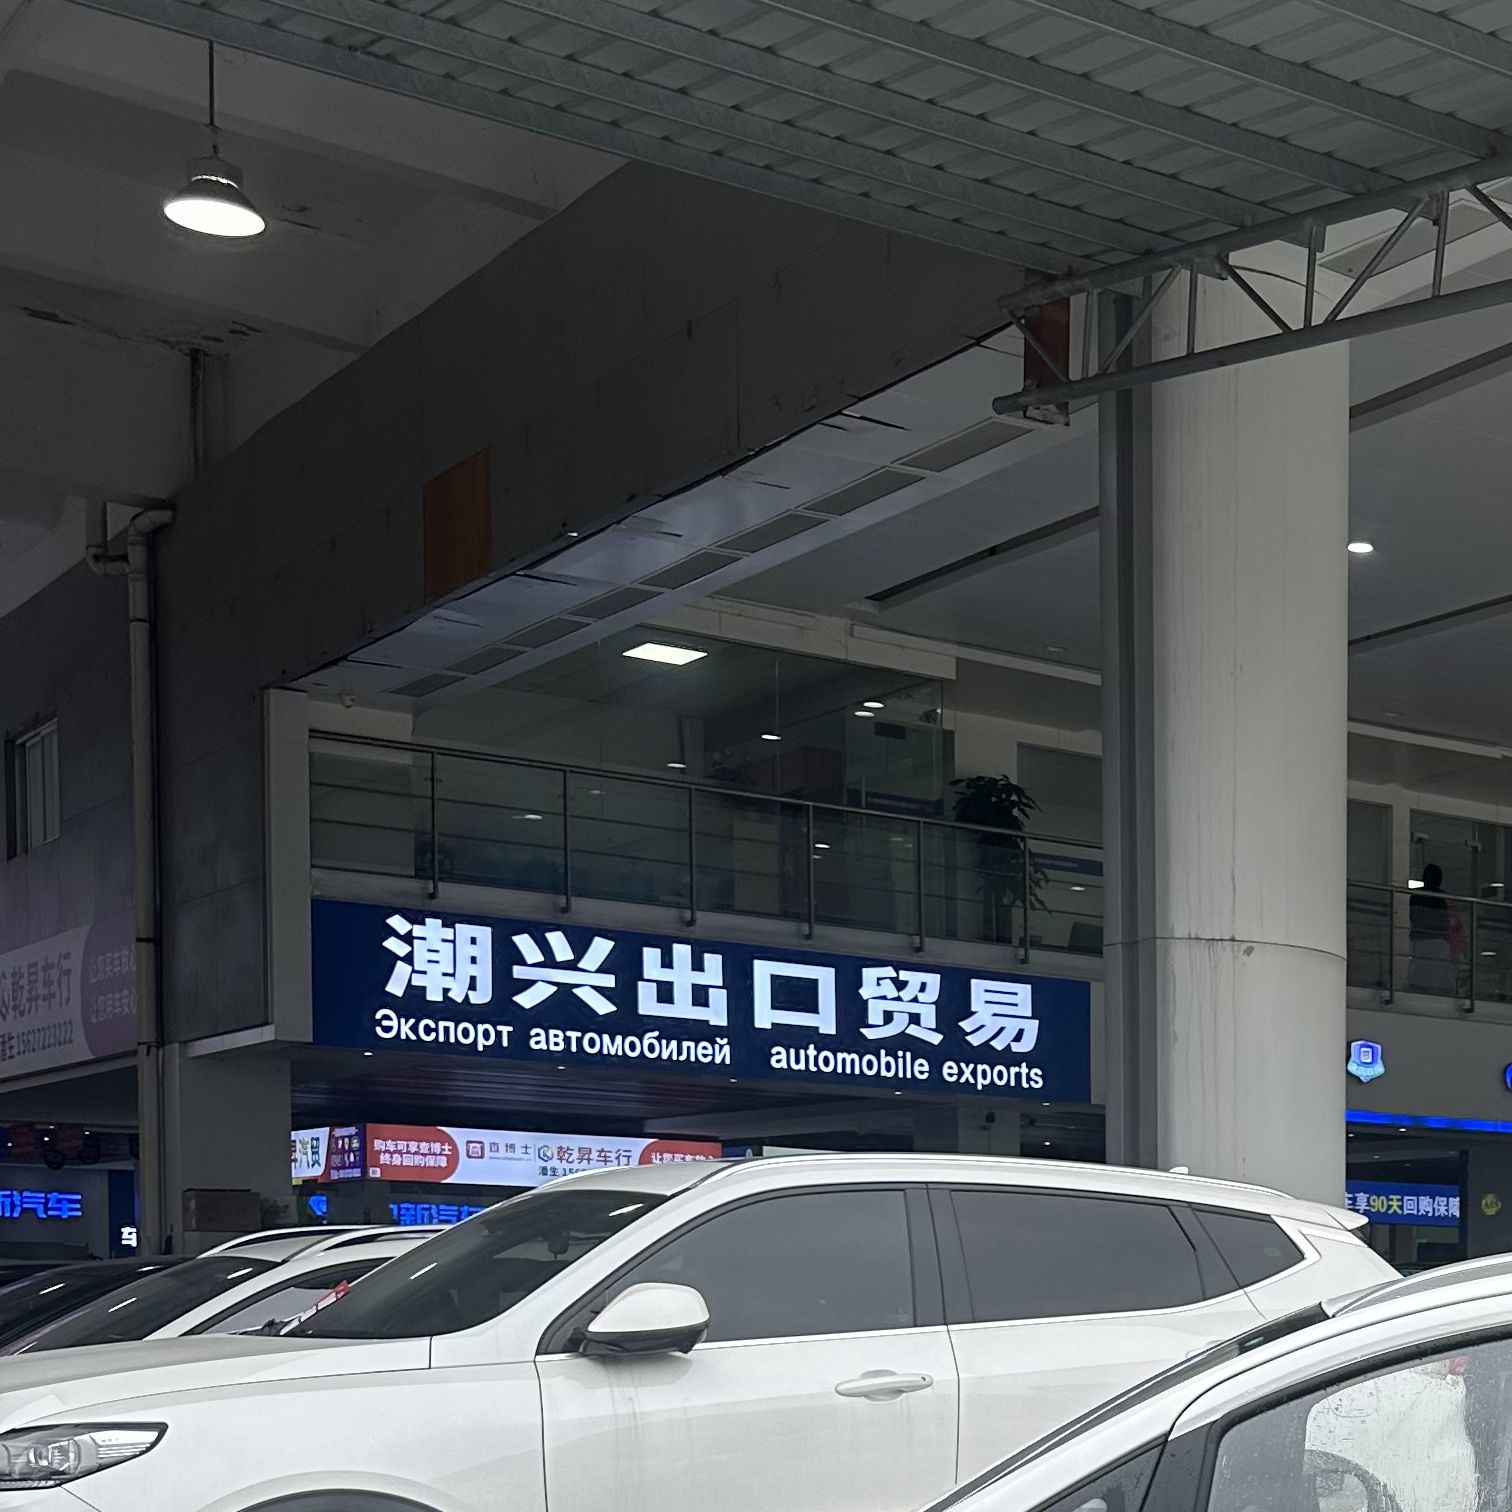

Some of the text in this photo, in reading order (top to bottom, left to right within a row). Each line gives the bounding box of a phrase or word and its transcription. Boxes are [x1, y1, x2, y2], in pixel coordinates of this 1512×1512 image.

[381, 913, 1040, 1053] 潮兴出口贸易
[374, 1009, 731, 1066] Экспорт автомобилей
[770, 1043, 1044, 1091] automobile exports
[556, 1145, 633, 1167] 乾昇车行
